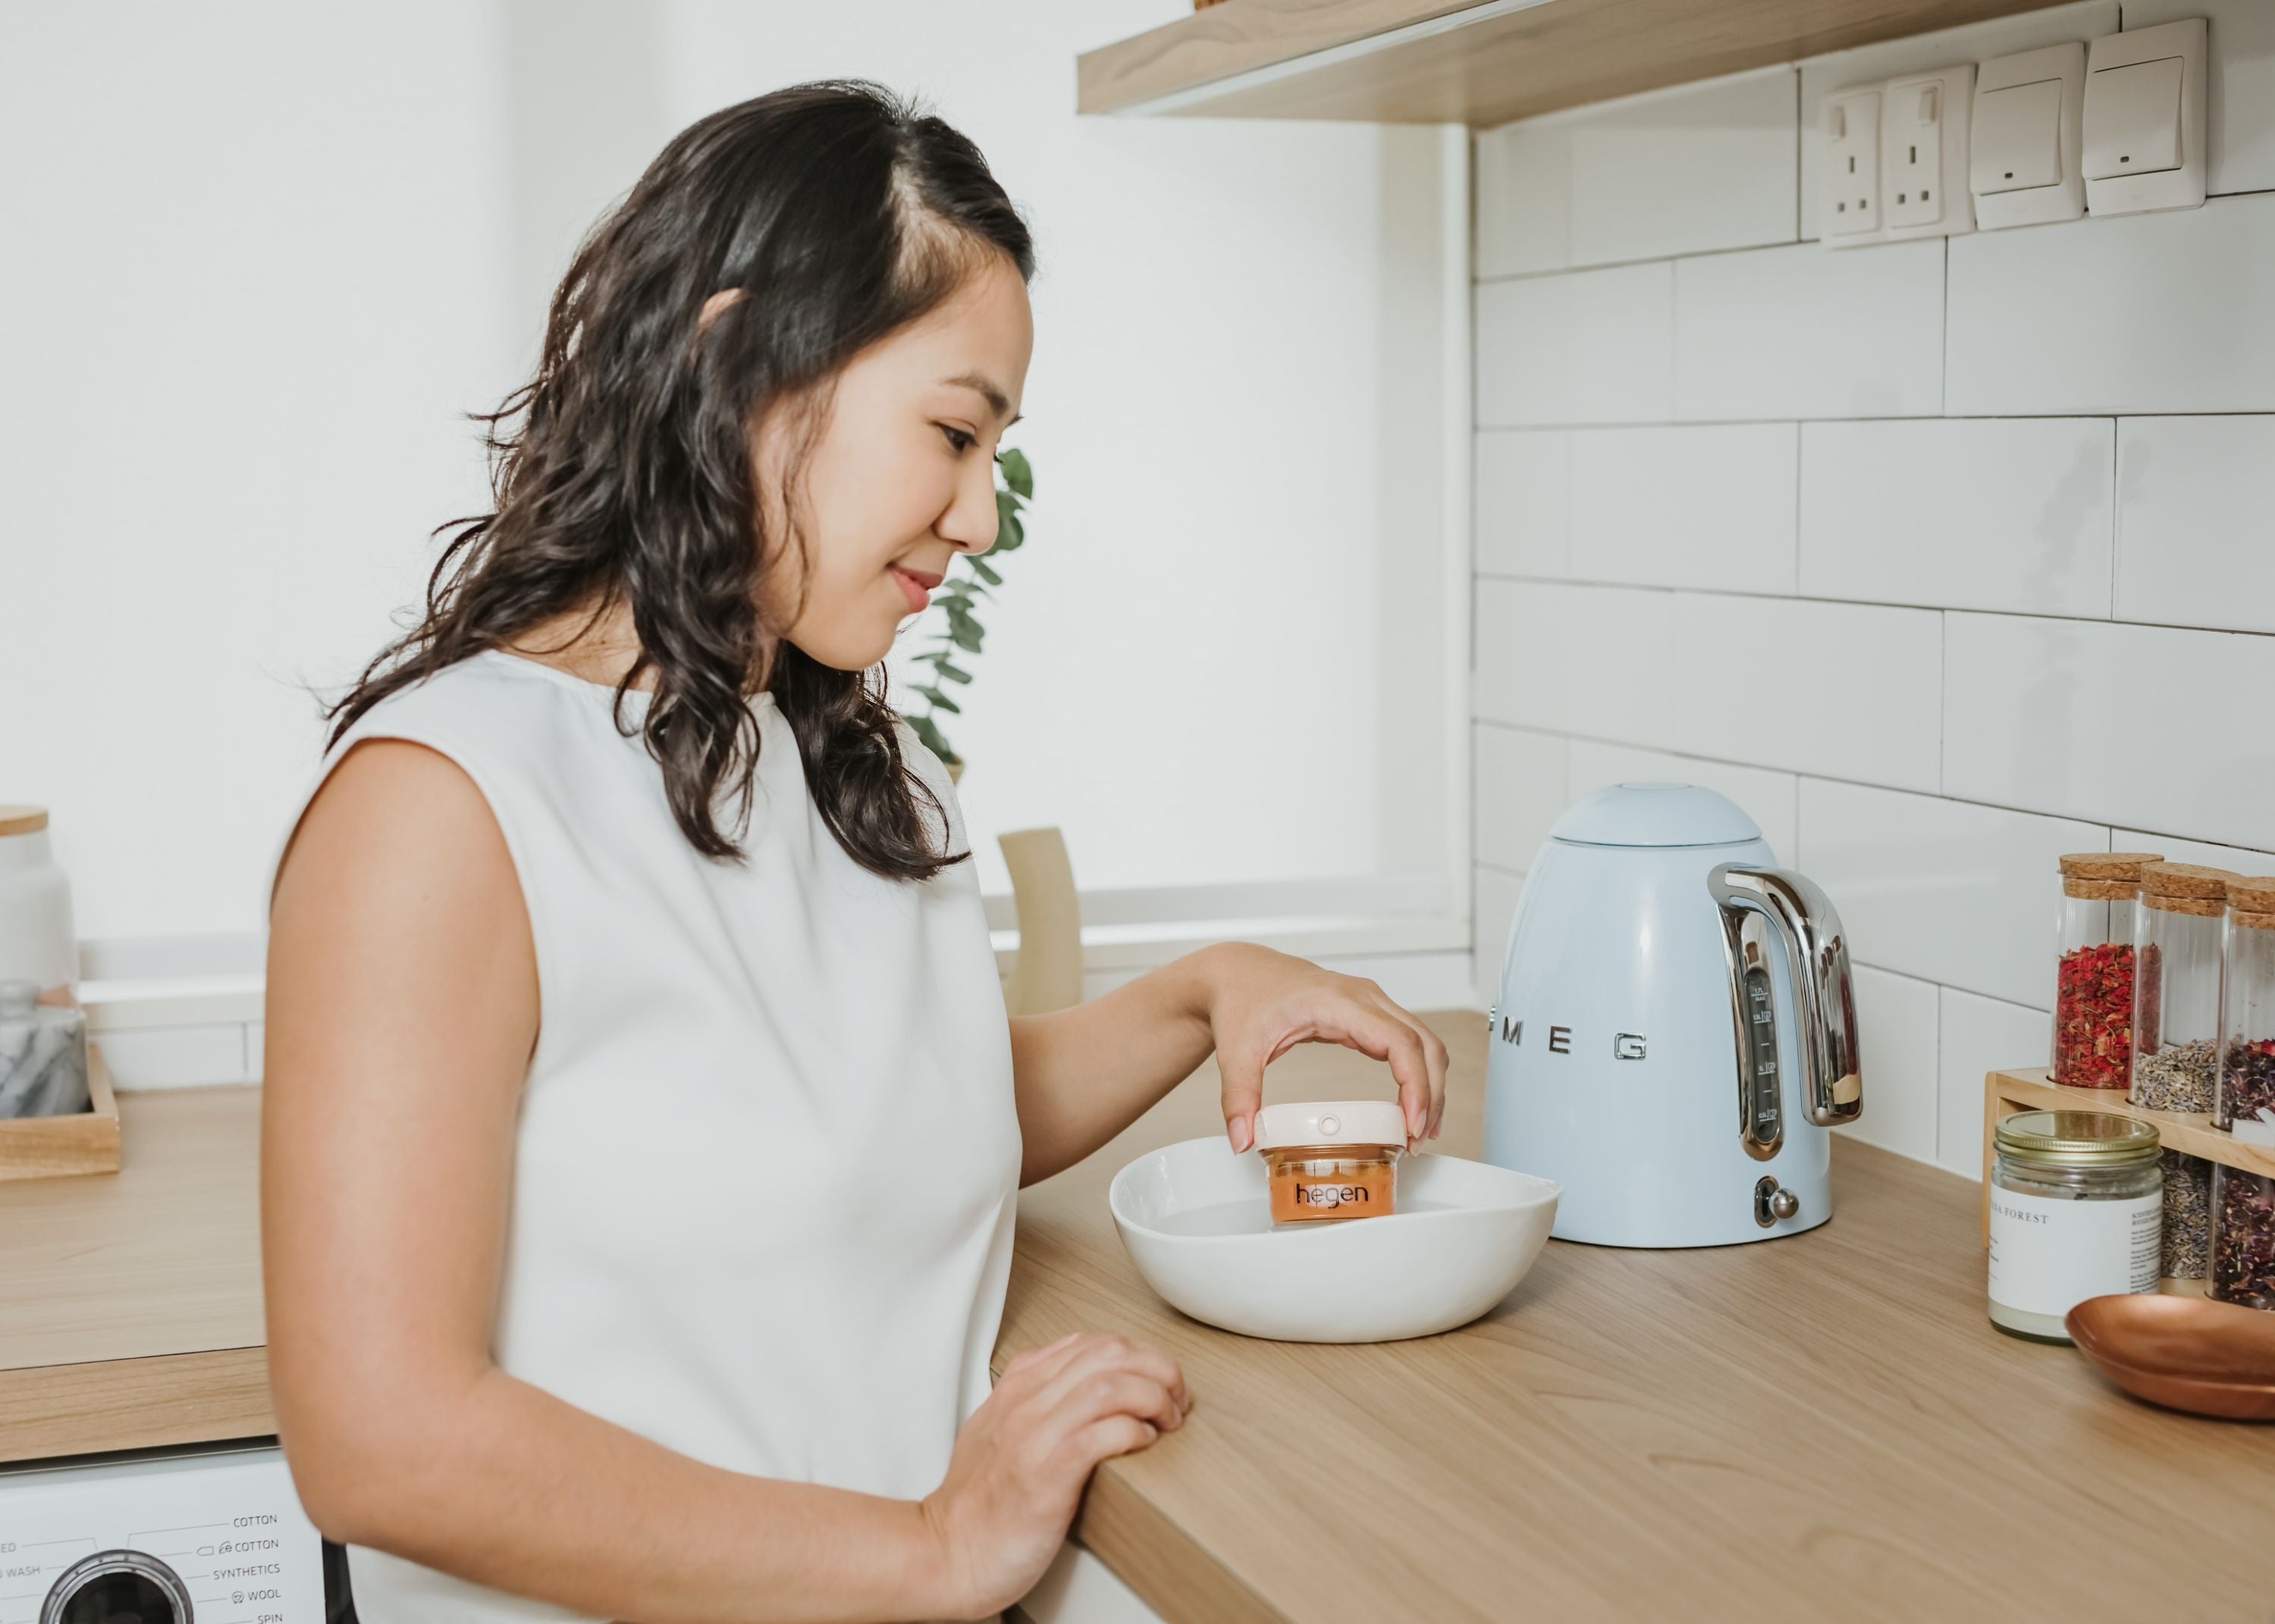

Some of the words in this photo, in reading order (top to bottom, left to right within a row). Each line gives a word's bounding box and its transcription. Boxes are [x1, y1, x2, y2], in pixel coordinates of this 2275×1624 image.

[1296, 1183, 1369, 1209] hegen
[2004, 1207, 2049, 1224] FOREST
[234, 1514, 278, 1528] COTTON
[235, 1539, 279, 1552] COTTON
[6, 1566, 41, 1578] WASH
[213, 1563, 281, 1580] SYNTHETICS
[248, 1588, 281, 1601] WOOL
[257, 1613, 283, 1624] SPIN
